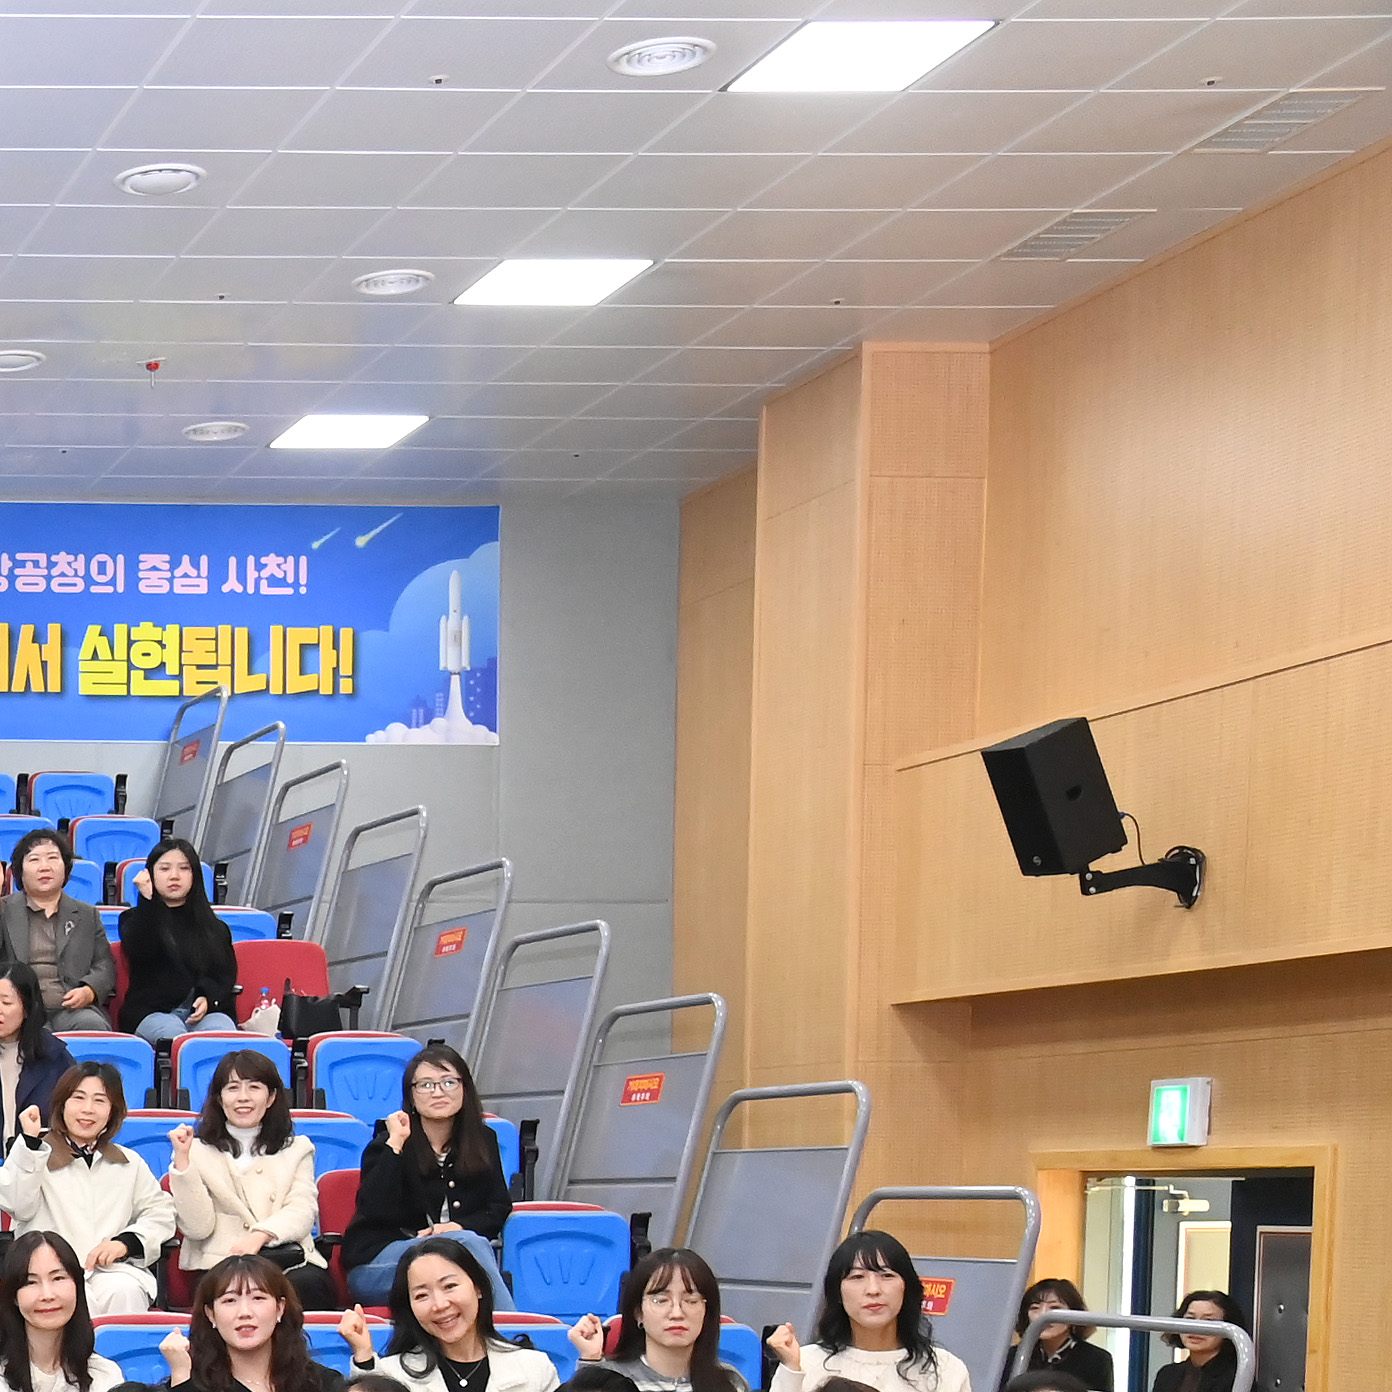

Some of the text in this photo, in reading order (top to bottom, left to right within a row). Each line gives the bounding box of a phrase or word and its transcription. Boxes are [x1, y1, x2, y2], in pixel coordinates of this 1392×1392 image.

[137, 553, 210, 596] 중심
[221, 553, 310, 597] 사천!
[78, 620, 355, 699] 실현됩니다!
